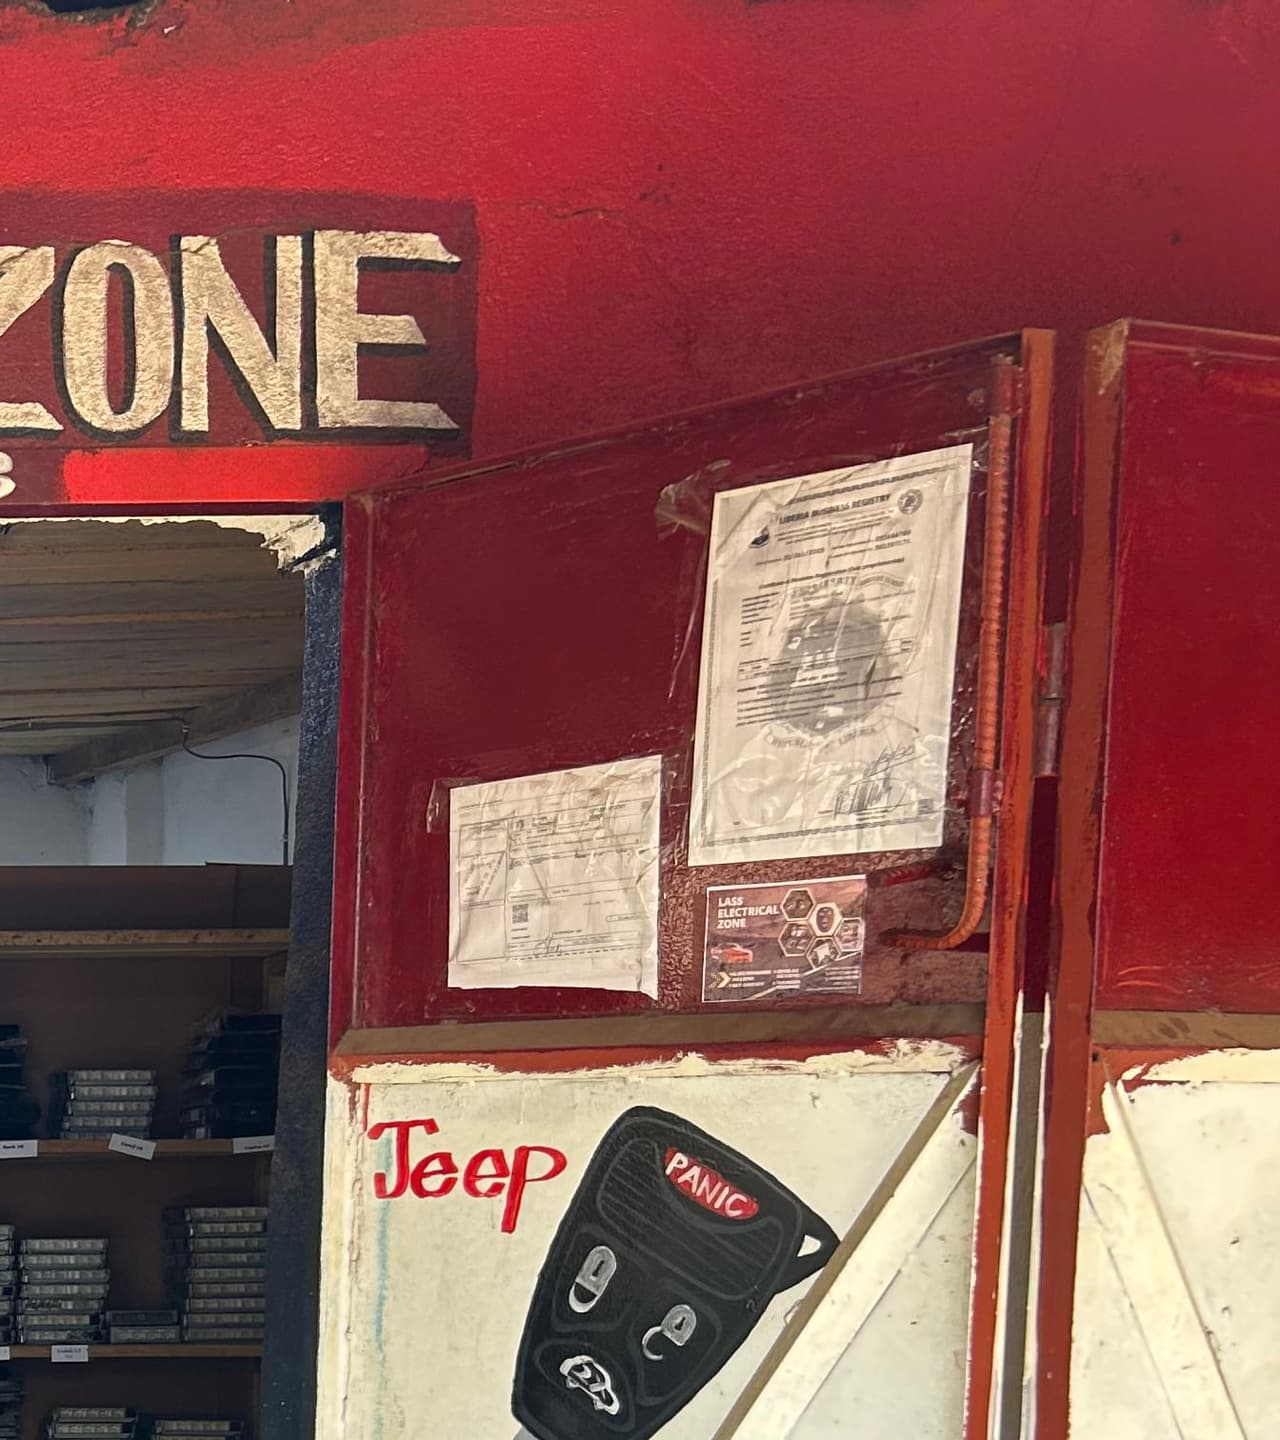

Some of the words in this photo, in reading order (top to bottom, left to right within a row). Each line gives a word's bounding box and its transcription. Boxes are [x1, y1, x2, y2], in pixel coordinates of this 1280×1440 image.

[718, 896, 744, 908] LASS
[717, 905, 780, 919] ELECTRICAL
[717, 918, 747, 929] ZONE
[366, 1117, 568, 1234] Jeep
[665, 1151, 748, 1218] PANIC
